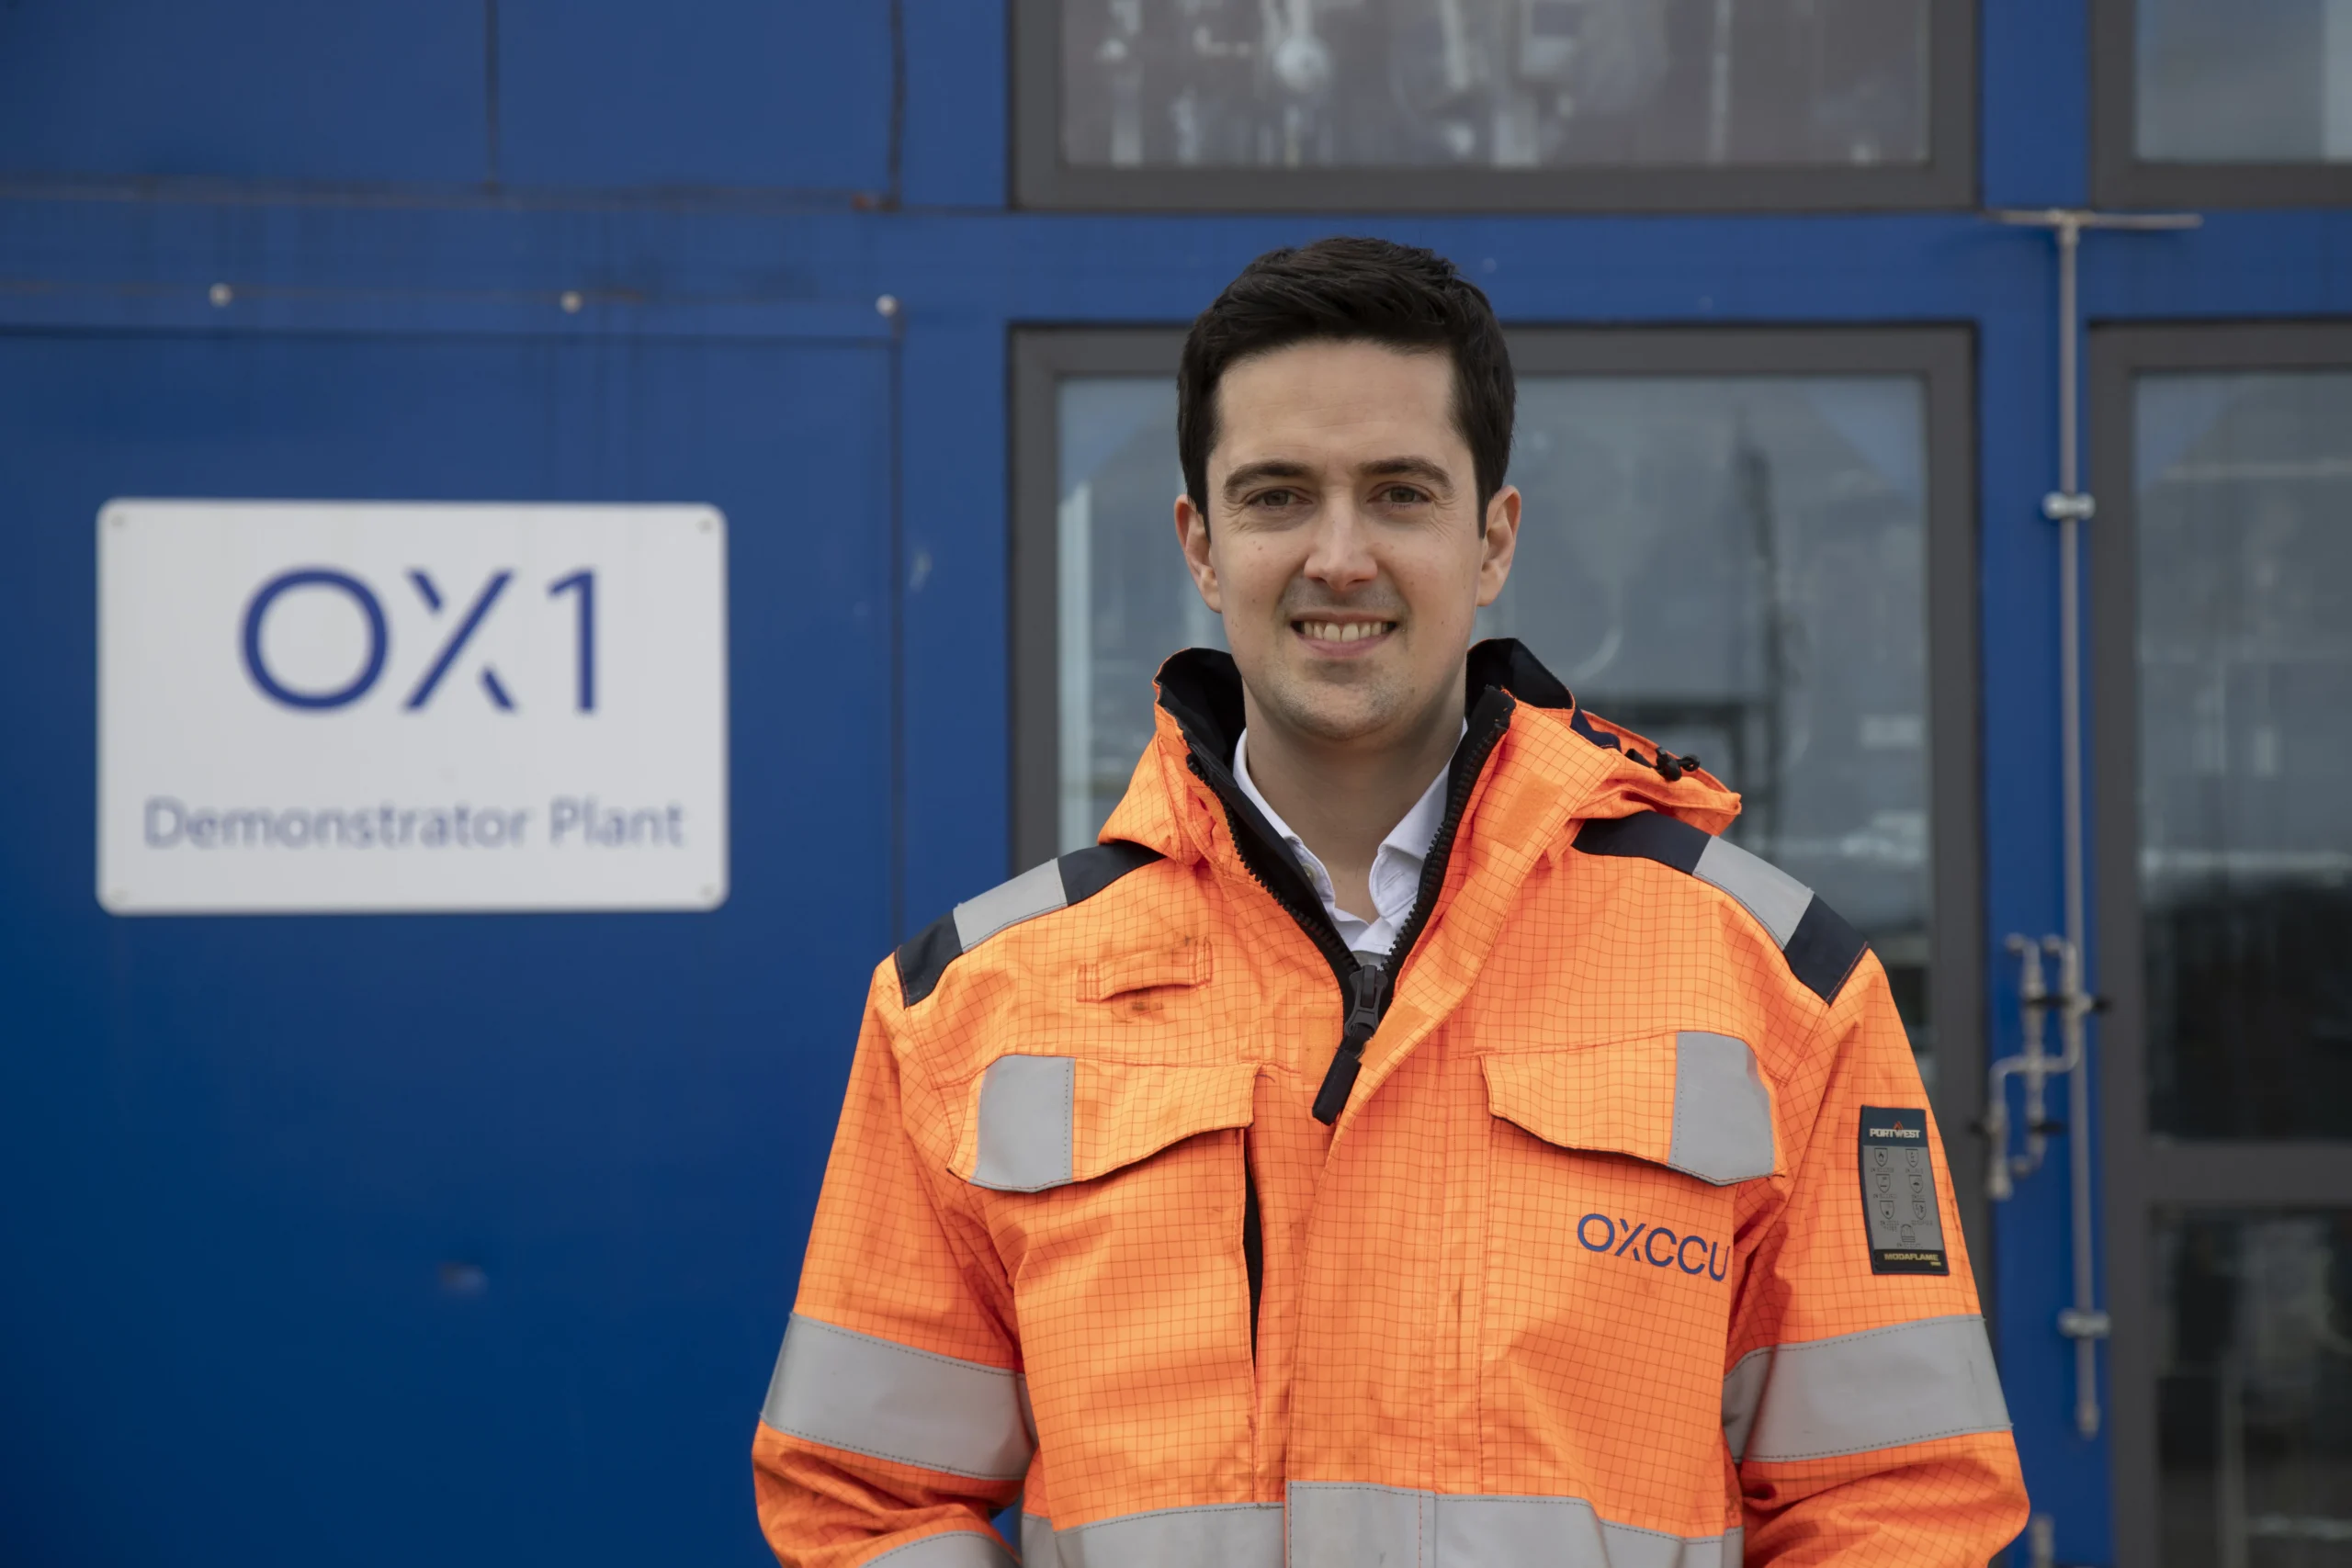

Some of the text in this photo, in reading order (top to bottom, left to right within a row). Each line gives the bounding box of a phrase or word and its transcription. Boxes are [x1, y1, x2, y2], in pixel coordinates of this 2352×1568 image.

[239, 566, 597, 715] OX1
[143, 795, 683, 849] Demonstrator Plant
[1870, 1128, 1921, 1139] PORTWEST
[1577, 1213, 1731, 1282] OXCCU
[1884, 1253, 1939, 1262] MODAFLAME
